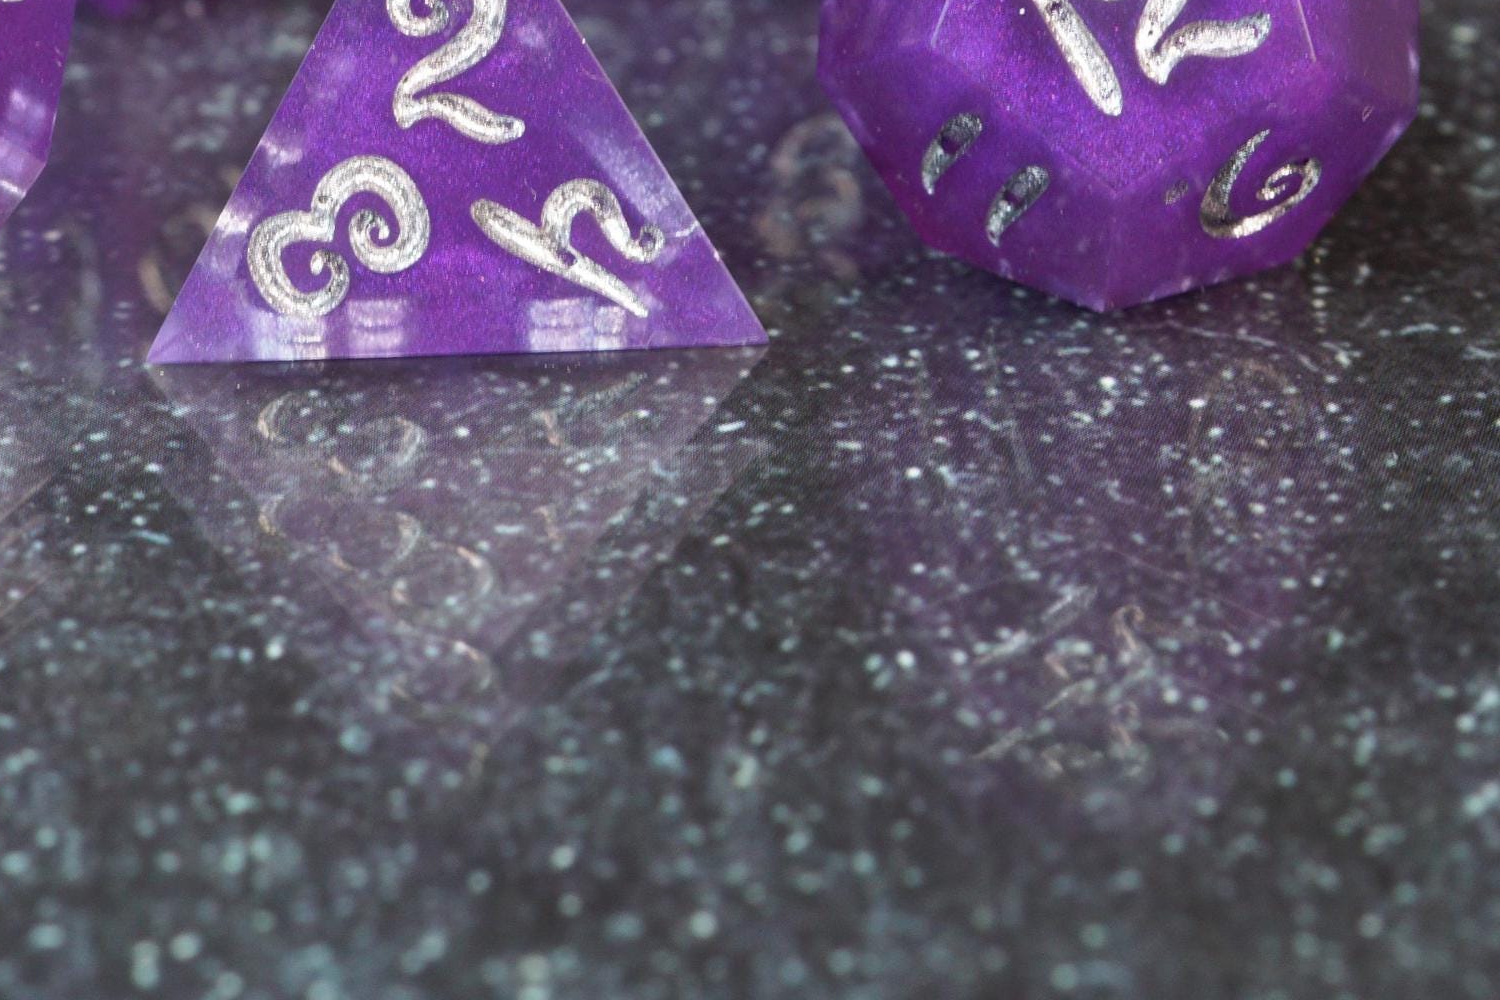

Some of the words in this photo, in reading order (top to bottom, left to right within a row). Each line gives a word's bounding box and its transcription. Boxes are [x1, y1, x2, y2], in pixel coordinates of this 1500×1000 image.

[246, 154, 431, 318] 3
[469, 177, 666, 318] 4
[920, 110, 1051, 248] 11
